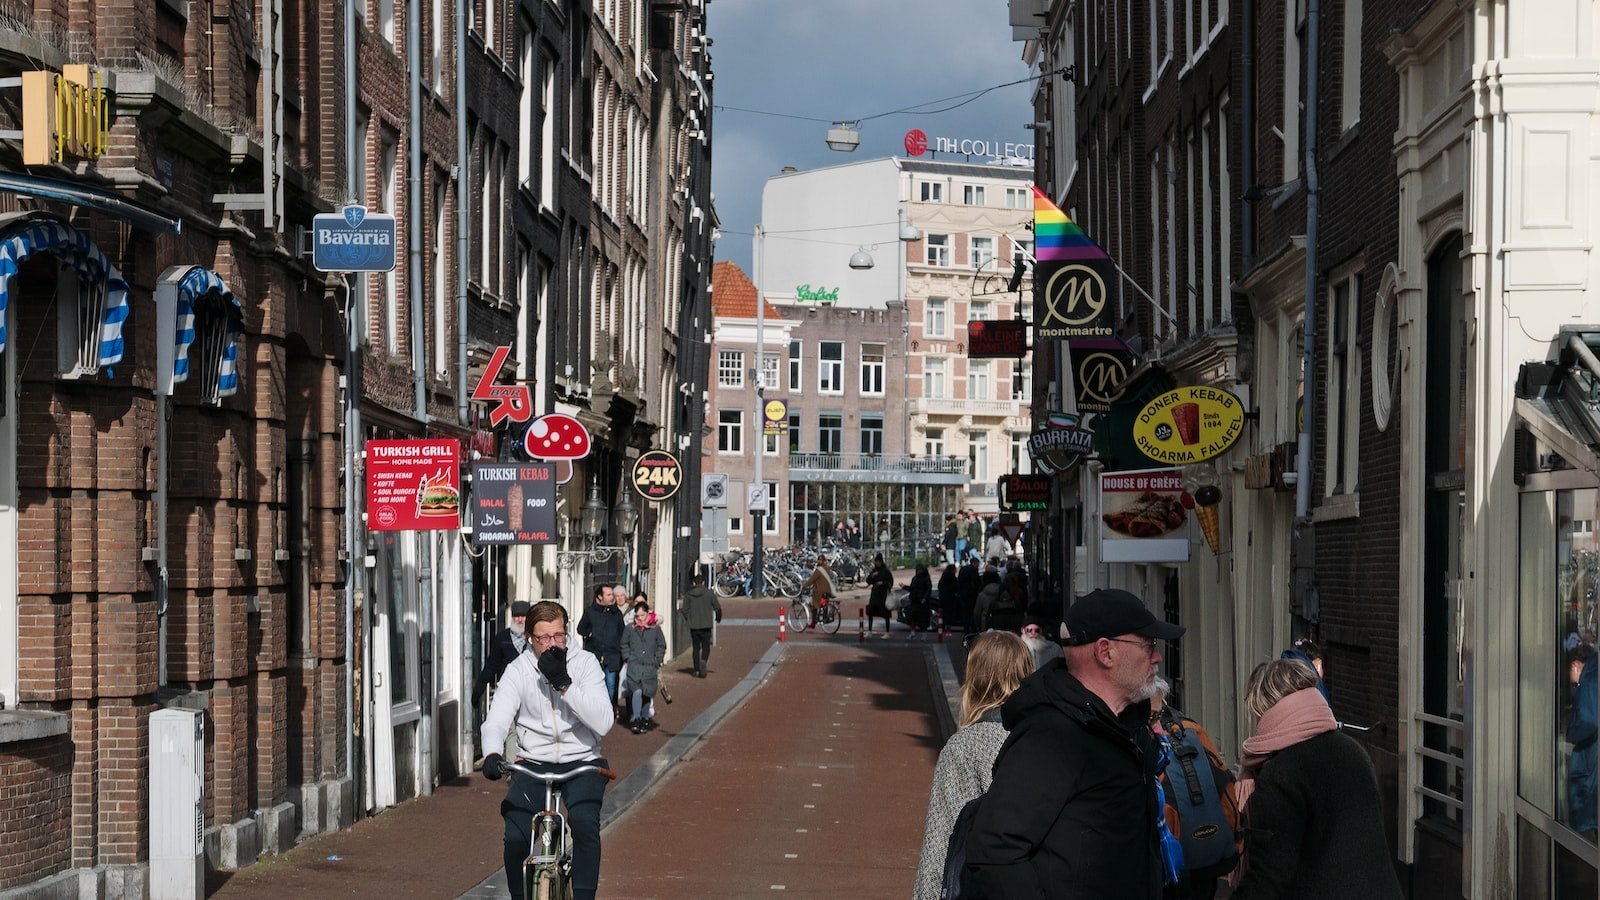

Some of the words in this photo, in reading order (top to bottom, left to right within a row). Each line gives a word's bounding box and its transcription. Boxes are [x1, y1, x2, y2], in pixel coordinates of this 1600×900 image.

[319, 228, 390, 246] Bavaria
[1039, 327, 1113, 337] montmartre
[490, 388, 522, 396] BAR
[1140, 392, 1180, 424] DONER
[1190, 389, 1233, 408] KEBAB
[1032, 430, 1093, 448] BURRATA
[1138, 436, 1195, 462] SHOARMA
[1200, 415, 1242, 457] FALAFEL
[373, 447, 423, 457] TURKISH
[424, 446, 453, 456] GRILL
[478, 468, 517, 481] TURKISH
[519, 468, 549, 481] KEBAB
[636, 466, 678, 485] 24K
[1103, 478, 1136, 489] HOUSE
[1136, 478, 1149, 489] OF
[480, 499, 505, 508] HALAL
[527, 498, 546, 507] FOOD
[480, 513, 505, 526] حلال
[479, 532, 515, 541] SHOARMA
[518, 532, 549, 541] FALAFEL
